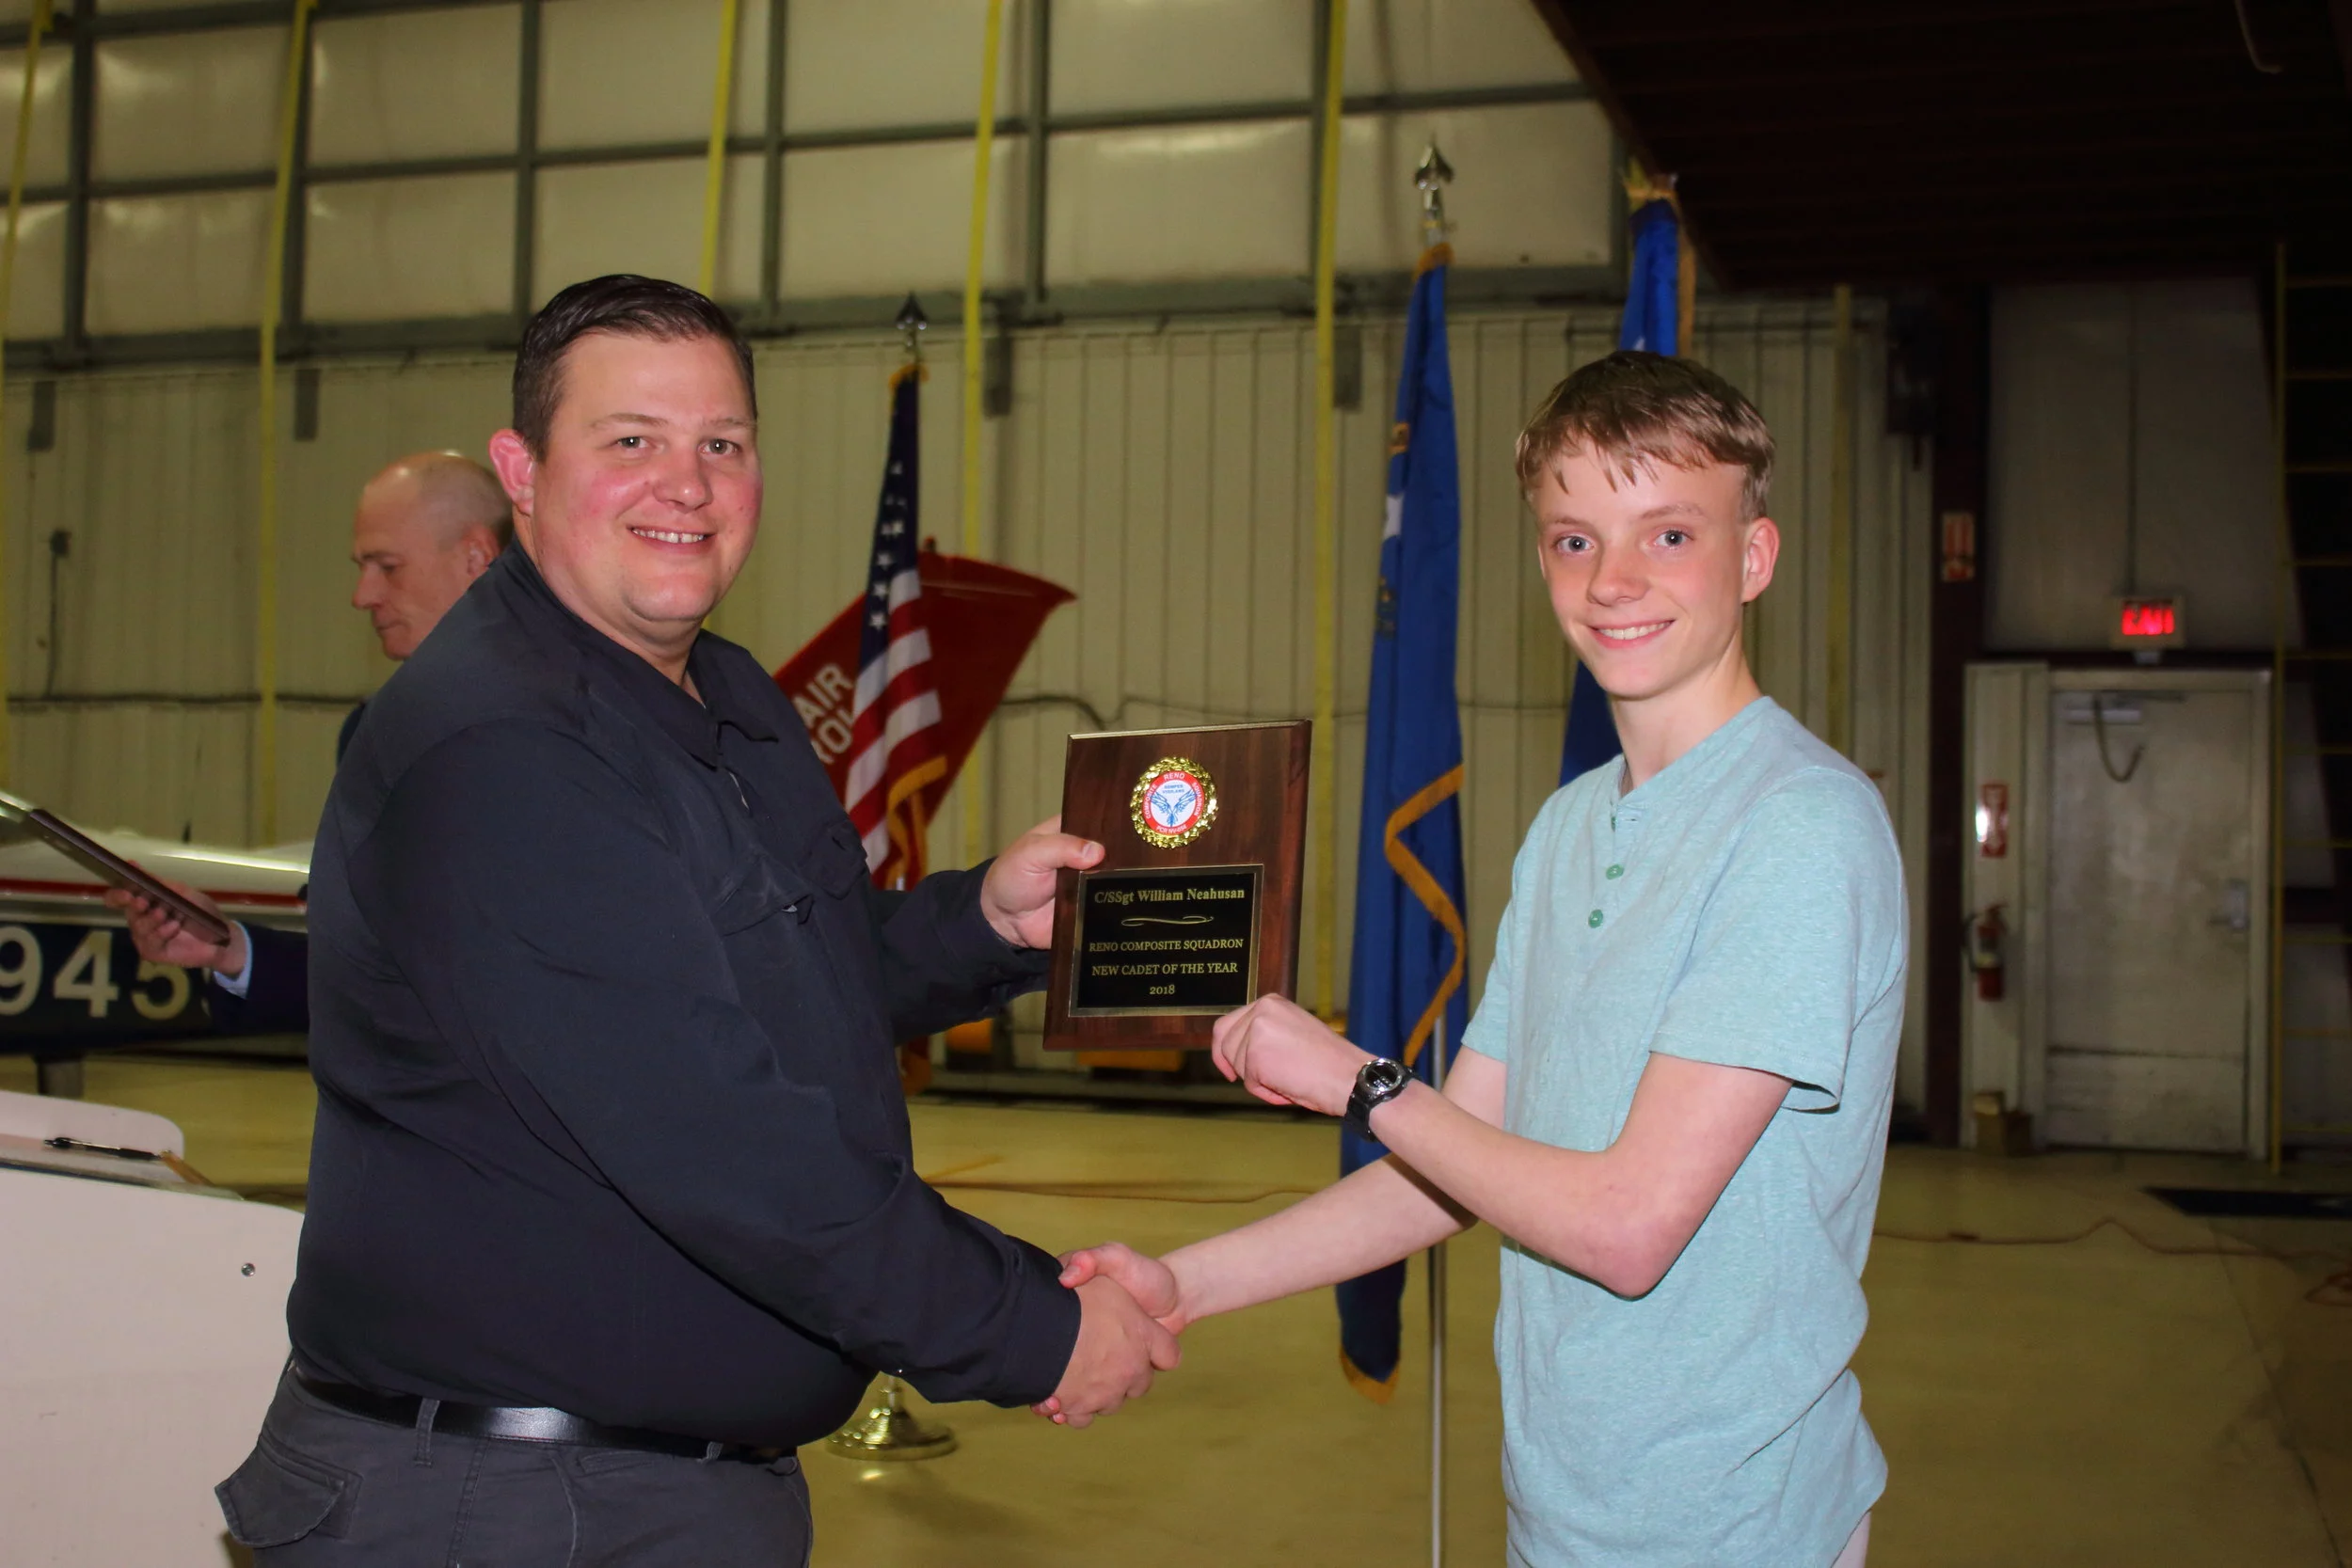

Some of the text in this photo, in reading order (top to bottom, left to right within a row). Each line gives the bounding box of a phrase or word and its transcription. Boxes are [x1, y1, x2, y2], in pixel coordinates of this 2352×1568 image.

[793, 662, 853, 729] AIR
[1163, 772, 1185, 781] RENO
[1094, 887, 1246, 905] C/SSgt William Neahusan
[1089, 939, 1244, 952] RENO COMPOSITE SQUADRON
[1091, 962, 1238, 976] NEW CADET OF THE YEAR
[1150, 984, 1176, 995] 2018
